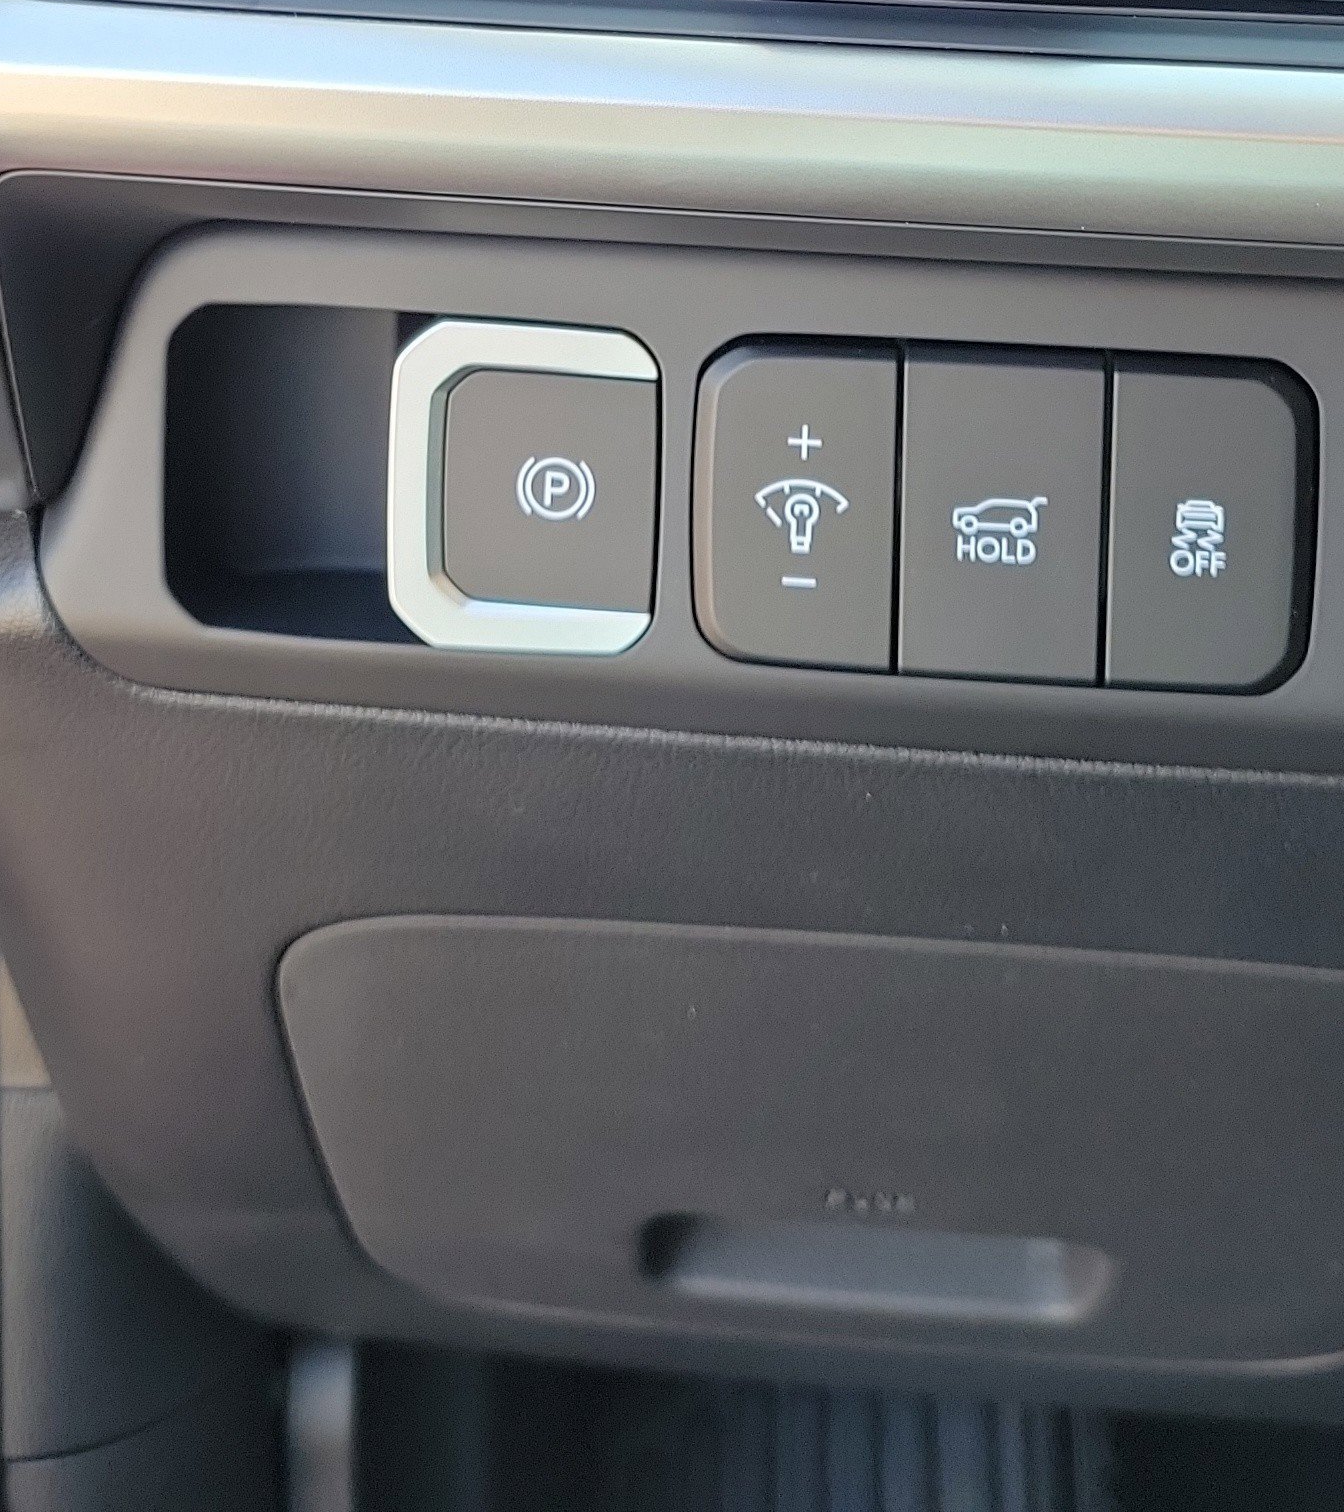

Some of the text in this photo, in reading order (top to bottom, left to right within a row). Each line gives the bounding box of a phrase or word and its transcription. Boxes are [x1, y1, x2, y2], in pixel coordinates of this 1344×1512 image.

[543, 470, 571, 507] P
[956, 534, 1037, 565] HOLD
[1169, 549, 1227, 578] OFF
